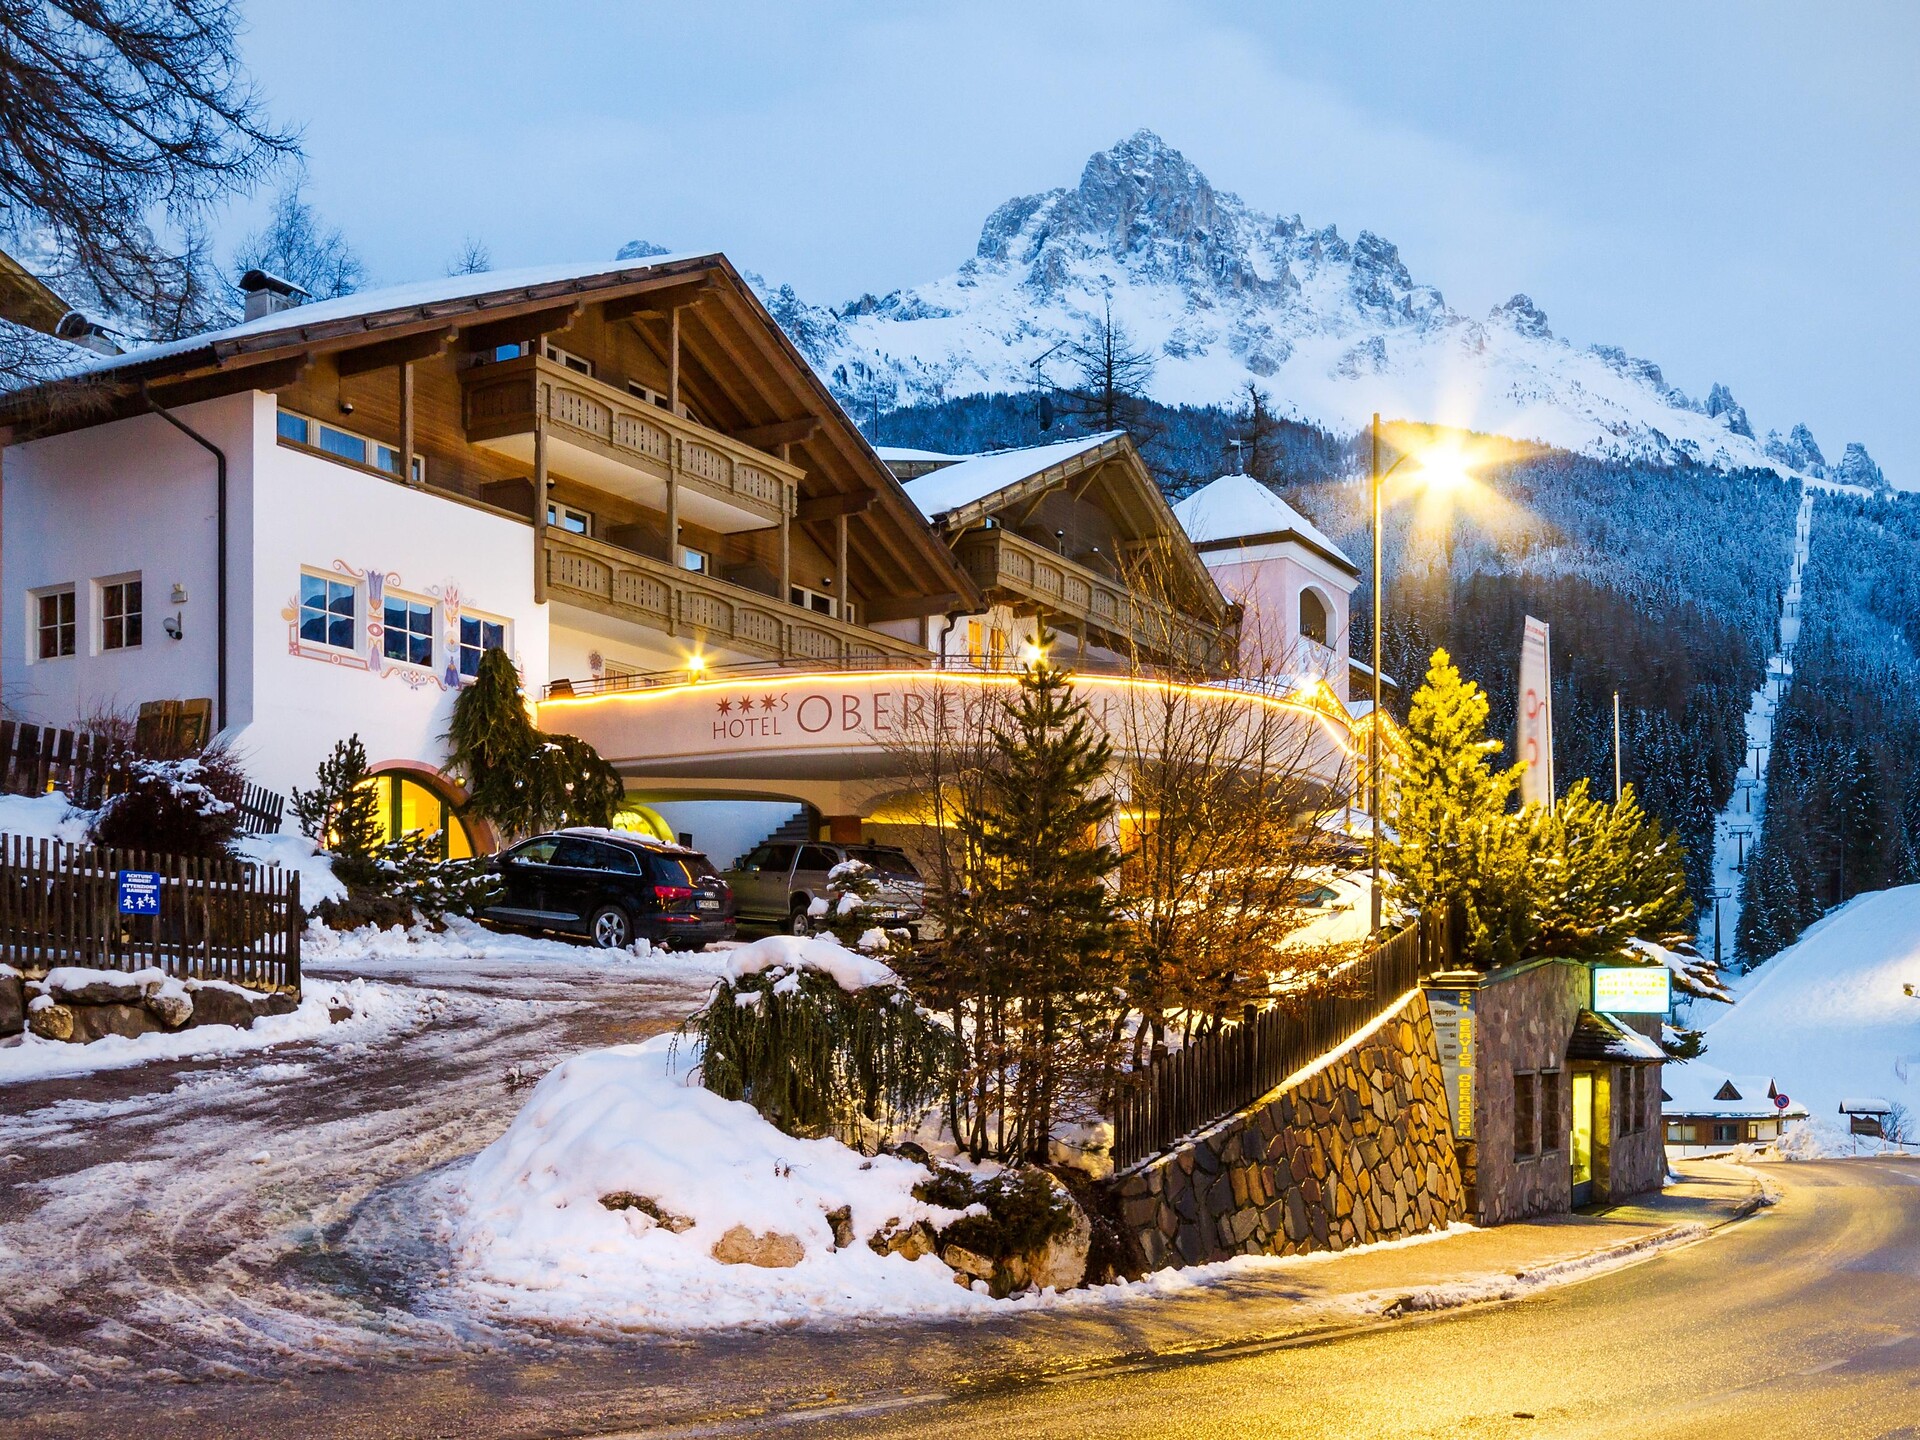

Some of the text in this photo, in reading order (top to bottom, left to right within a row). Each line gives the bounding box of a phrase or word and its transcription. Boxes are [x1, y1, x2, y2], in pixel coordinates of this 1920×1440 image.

[713, 691, 1108, 739] HOTEL OBEREGN
[1458, 991, 1472, 1137] SKI SERVICE OBEREGGEN
